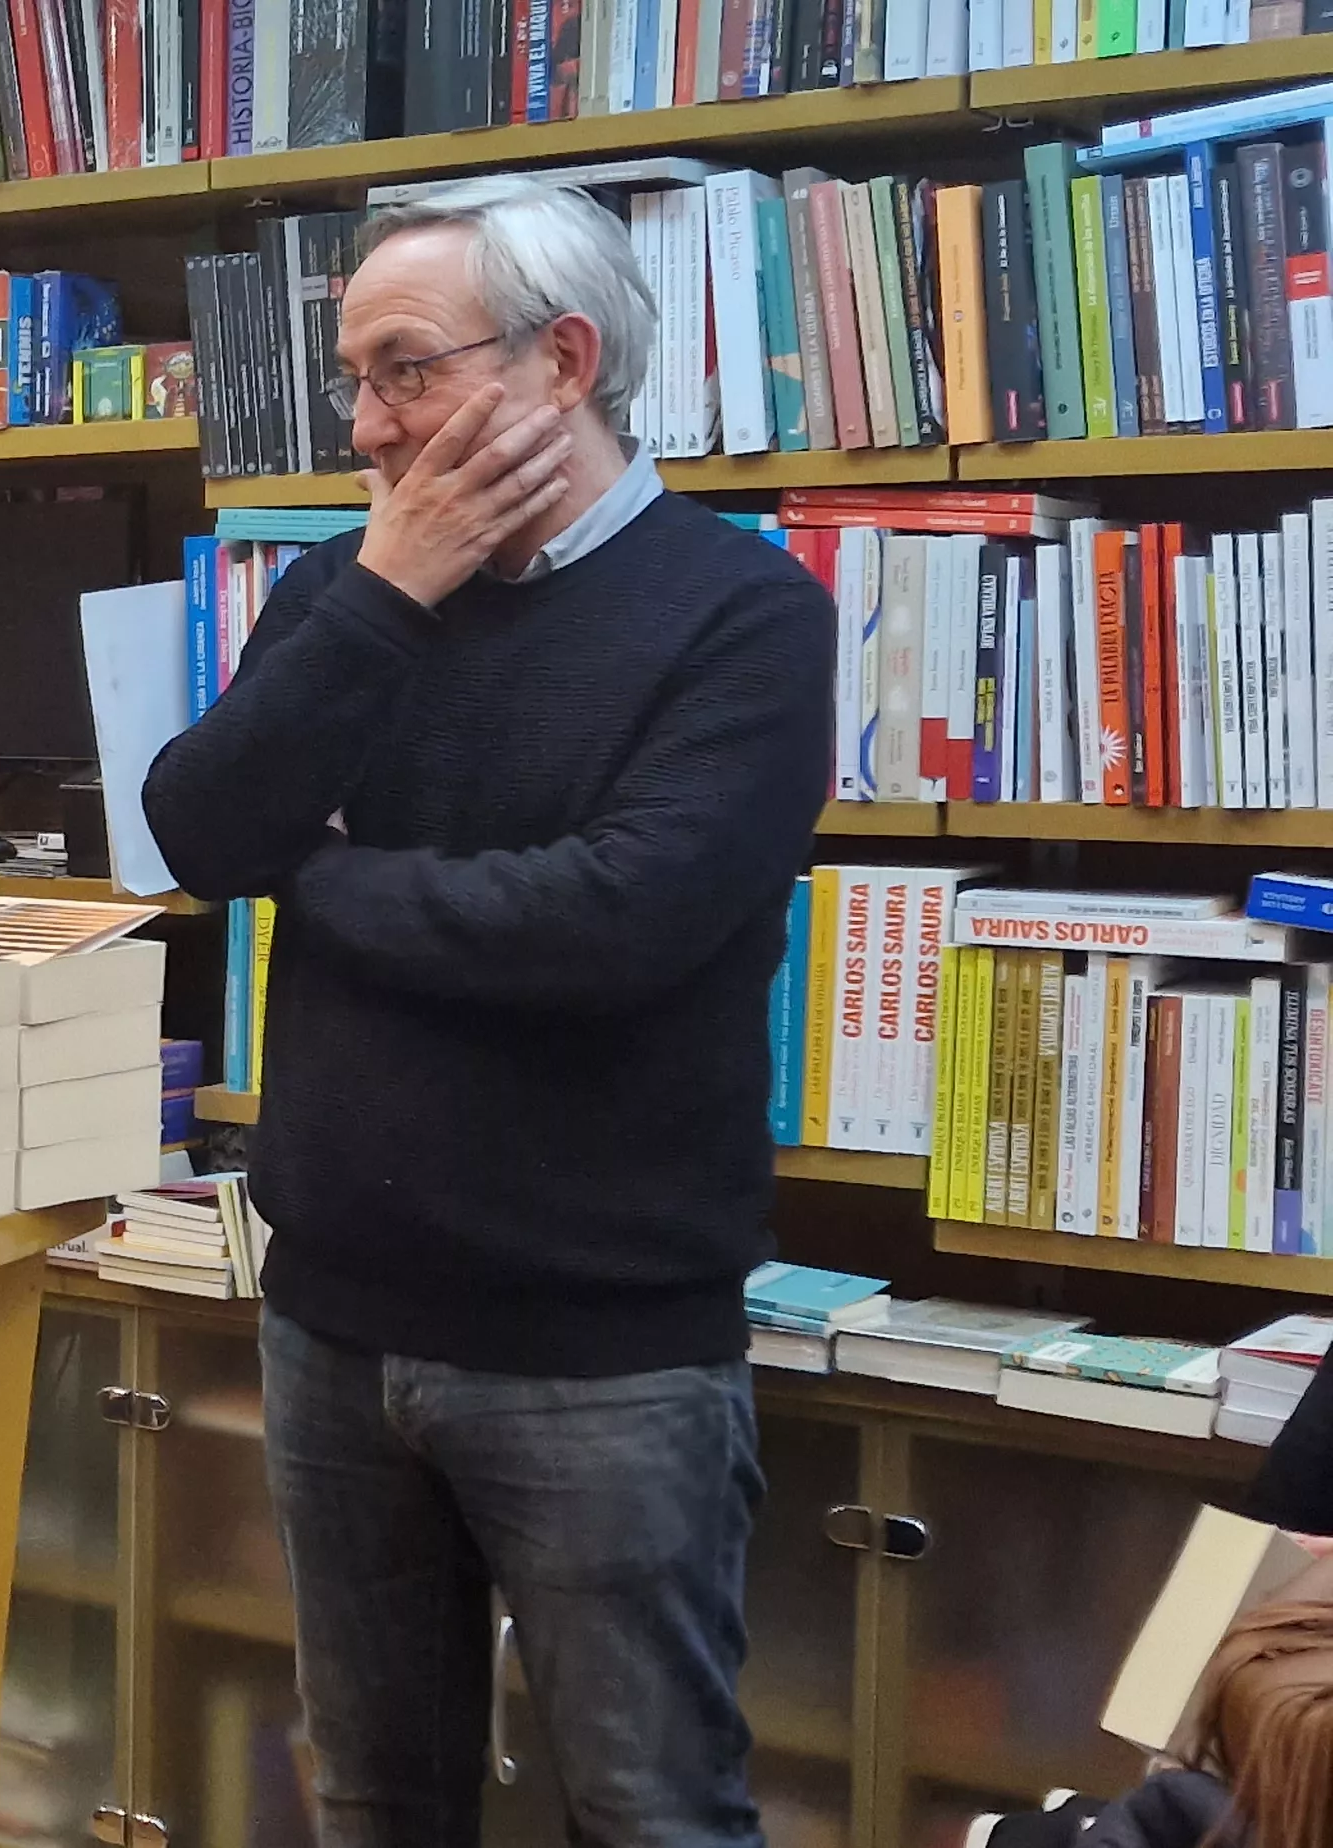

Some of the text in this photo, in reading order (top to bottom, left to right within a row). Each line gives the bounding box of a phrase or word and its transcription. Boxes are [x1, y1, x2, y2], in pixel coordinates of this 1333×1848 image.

[726, 186, 742, 281] Pablo Picasso
[18, 316, 32, 386] TENNIS
[1100, 630, 1119, 684] PALABRA
[1103, 689, 1119, 703] LA
[257, 916, 270, 963] DYER
[843, 883, 870, 1037] CARLOS SAURA
[878, 884, 908, 1040] CARLOS SAURA
[914, 885, 943, 1042] CARLOS SAURA
[970, 916, 1149, 947] CARLOS SAURA
[1039, 963, 1062, 1056] ALBERT ESPINOSA
[1283, 990, 1299, 1124] ILUMINA TUS SOMBRAS
[1011, 1123, 1029, 1174] ESPINOSA
[1208, 1093, 1225, 1166] DIGNIDAD
[986, 1121, 1007, 1212] ALBERT ESPINOSA
[1009, 1177, 1028, 1215] ALBERT
